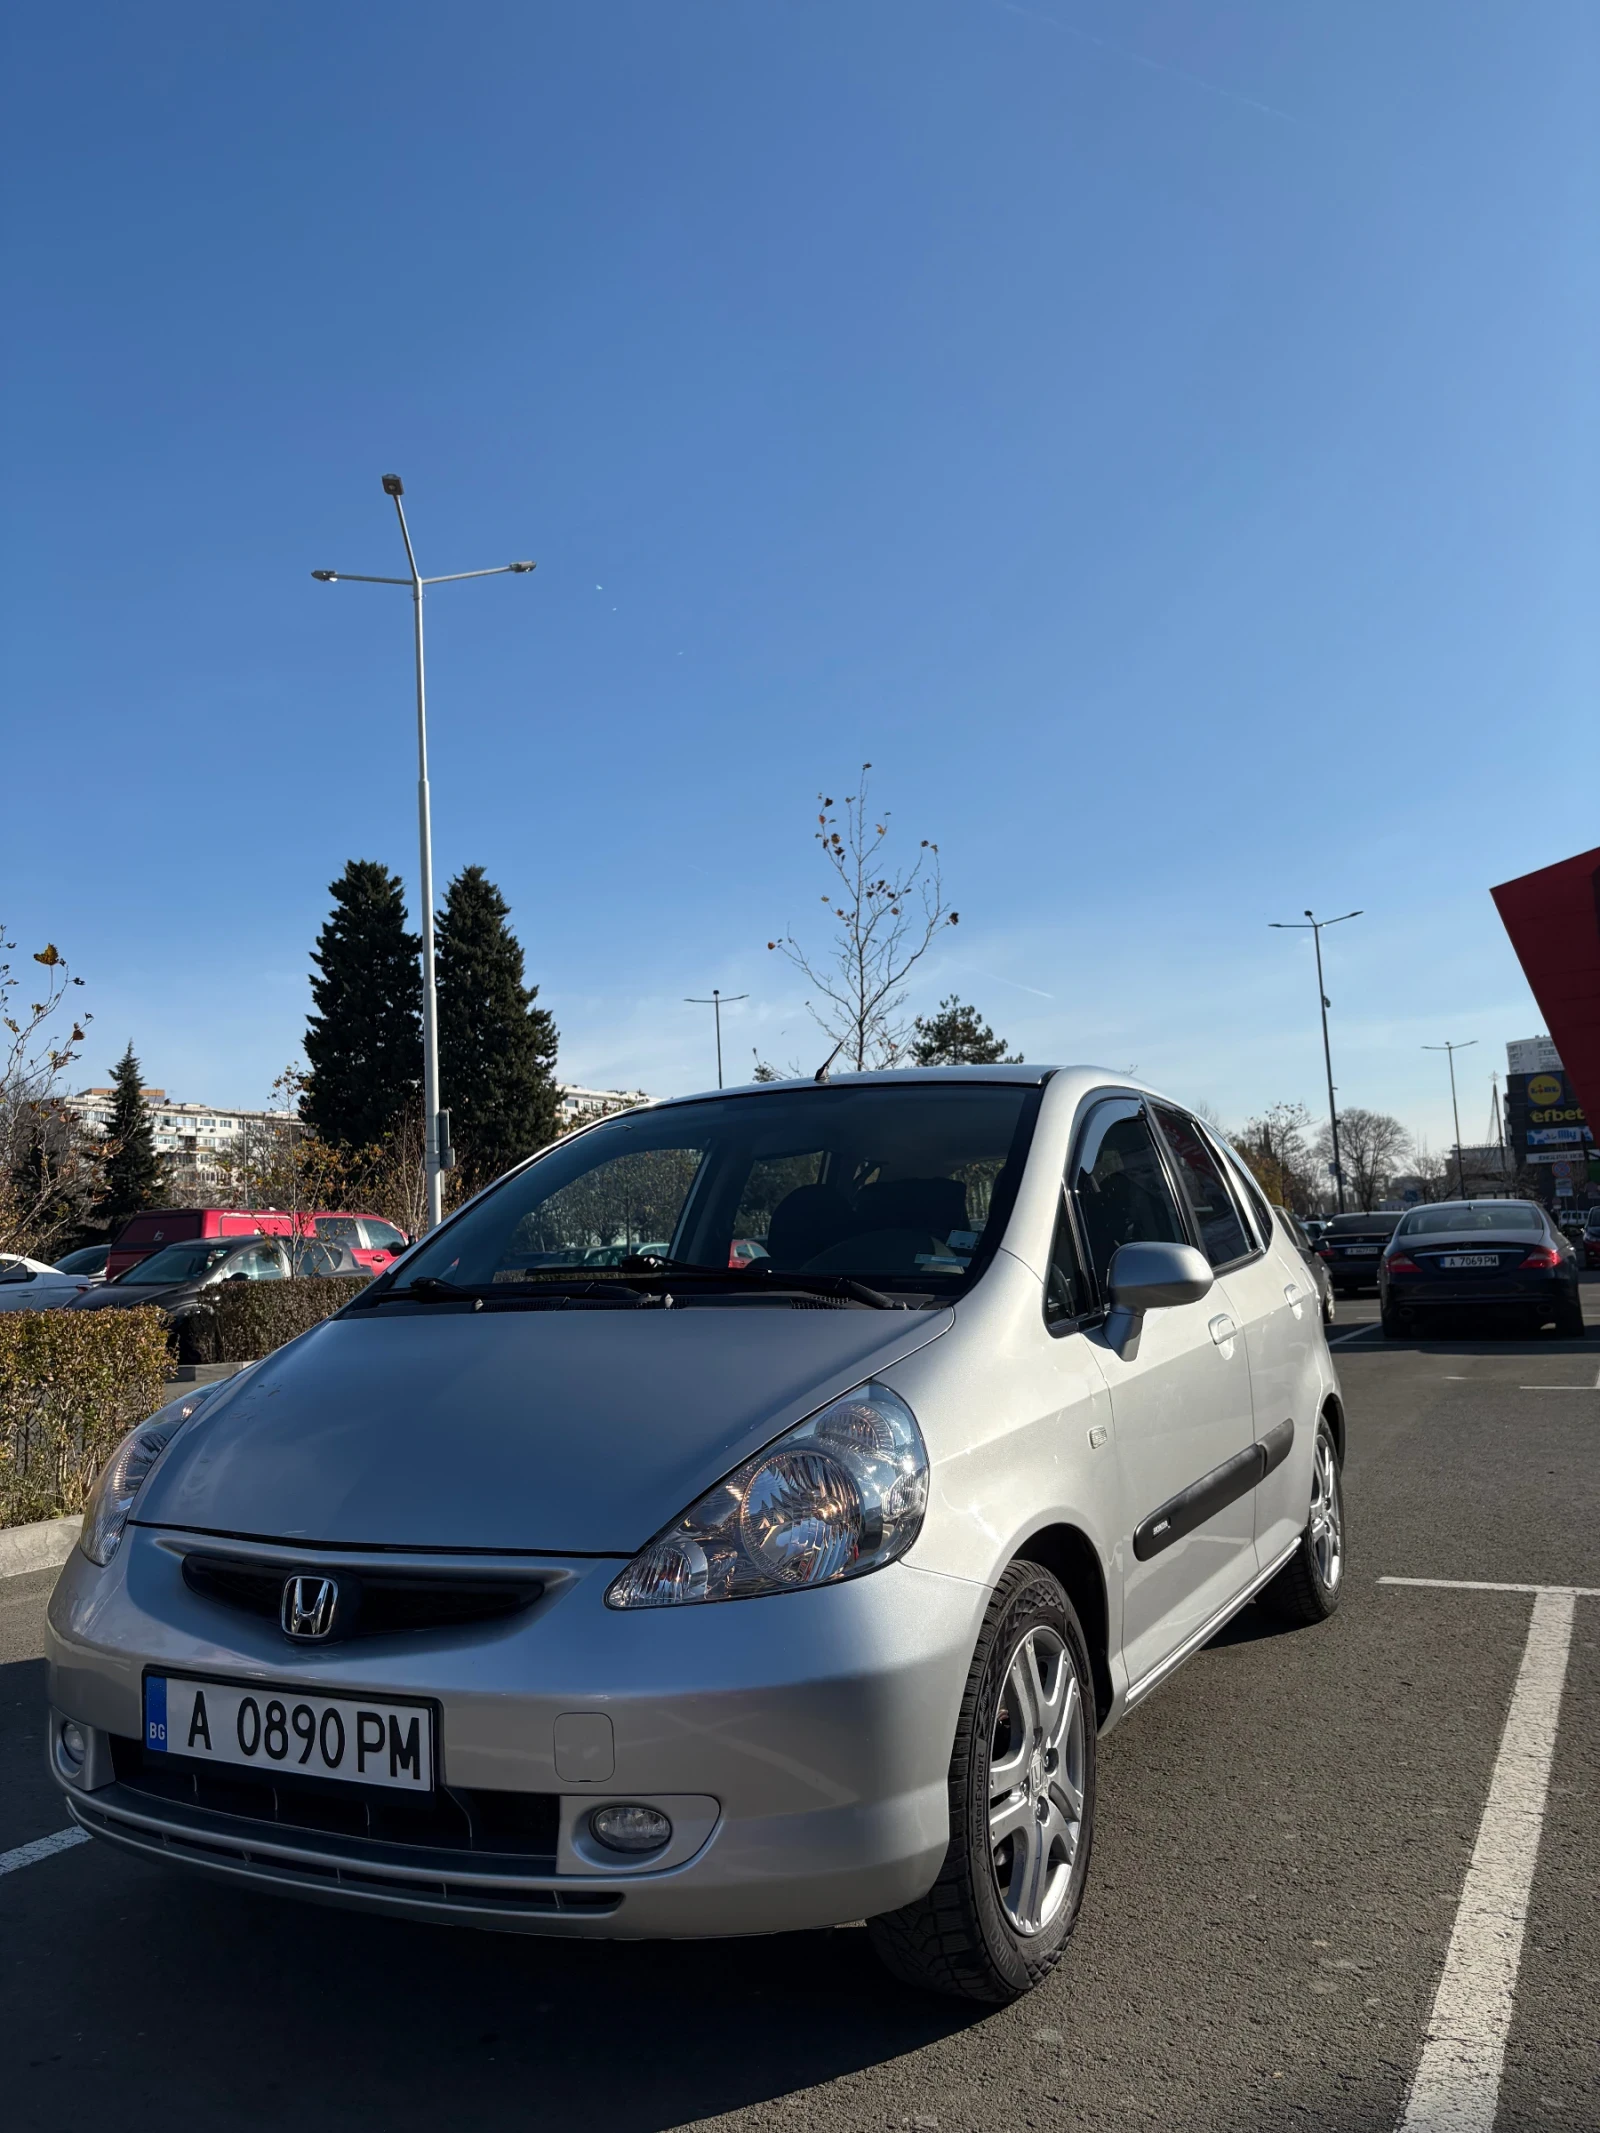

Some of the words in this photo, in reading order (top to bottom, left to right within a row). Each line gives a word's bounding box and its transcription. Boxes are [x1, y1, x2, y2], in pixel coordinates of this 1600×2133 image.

[1530, 1108, 1585, 1123] efbet
[1460, 1256, 1483, 1266] 7069
[149, 1721, 165, 1740] BG
[187, 1690, 213, 1751] A
[236, 1696, 346, 1769] 0890
[356, 1710, 421, 1780] PM
[974, 1750, 985, 1853] WinterExpert
